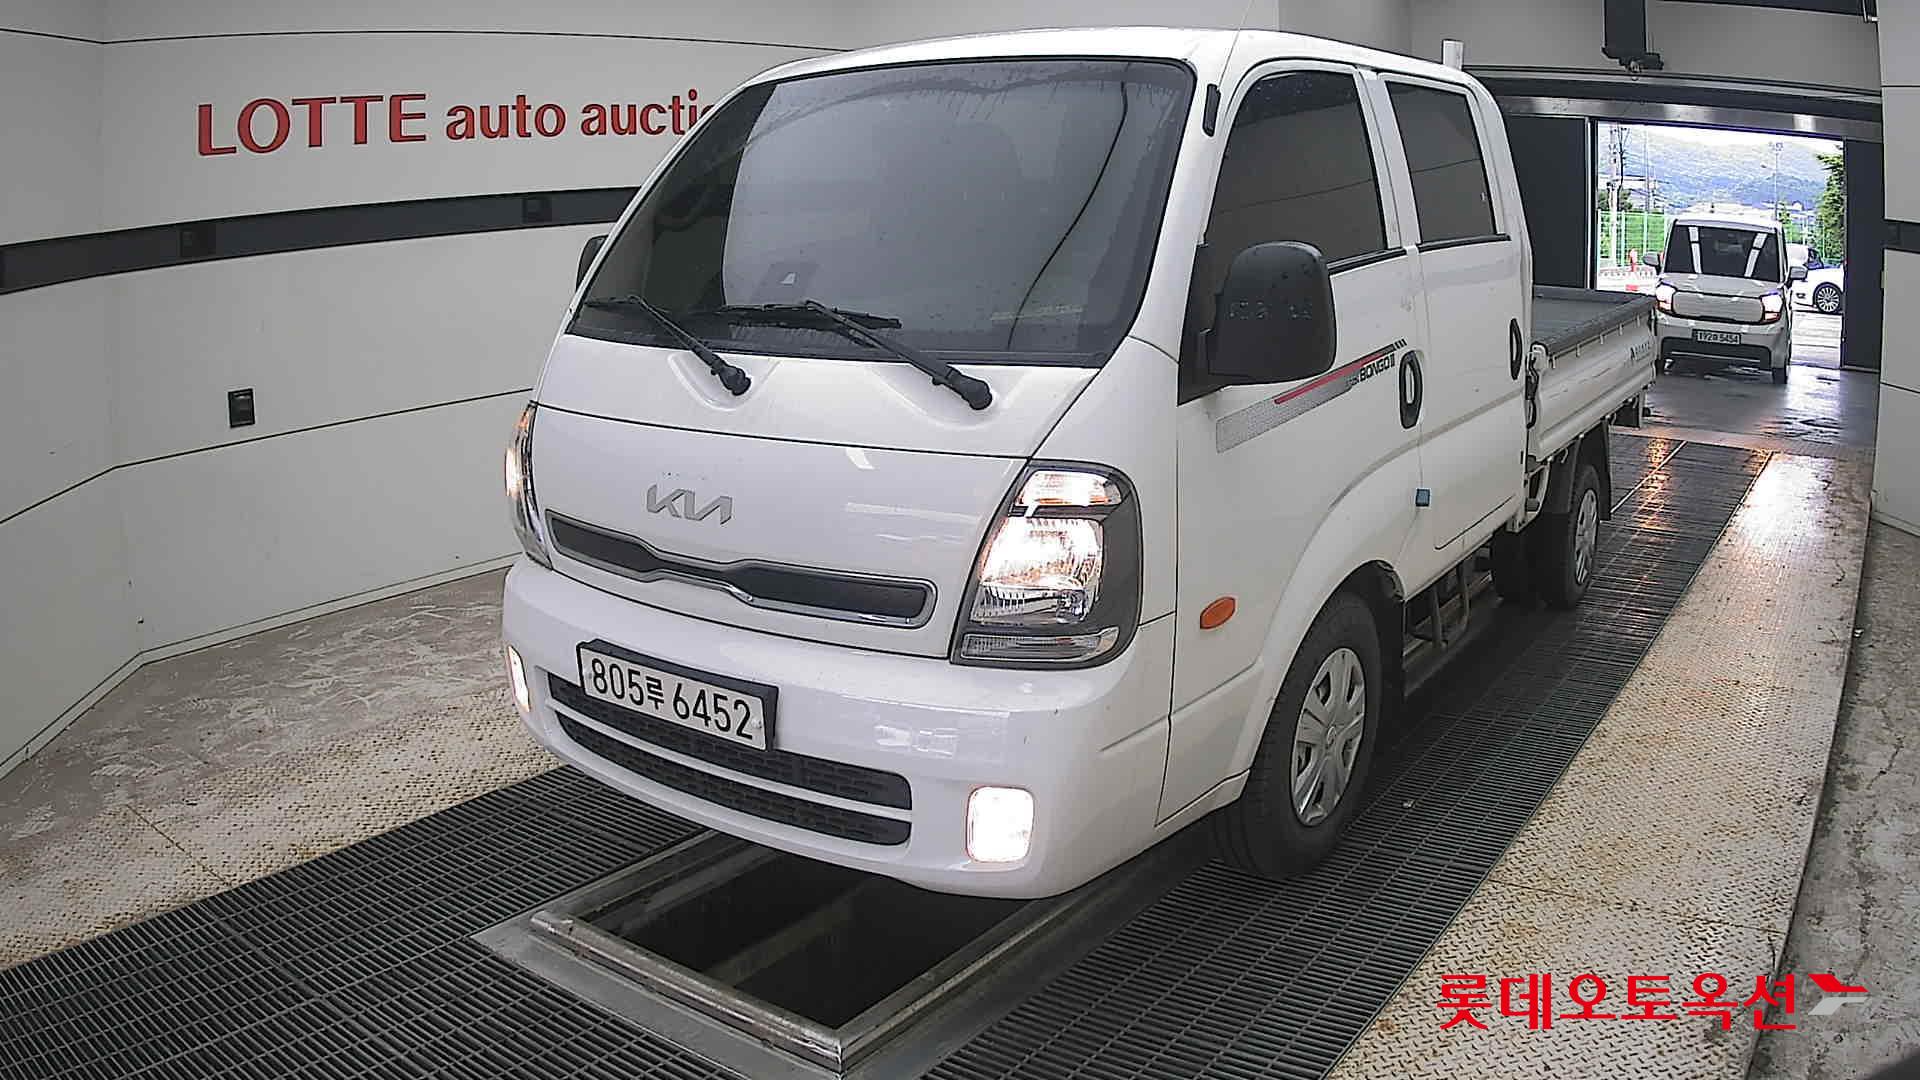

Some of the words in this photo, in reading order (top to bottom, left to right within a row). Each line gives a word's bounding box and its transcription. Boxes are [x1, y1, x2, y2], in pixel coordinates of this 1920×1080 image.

[197, 93, 427, 157] LOTTE
[445, 94, 567, 141] auto
[580, 88, 715, 137] aucti
[646, 483, 733, 525] KIA
[591, 657, 664, 711] 805루
[672, 682, 753, 740] 6452
